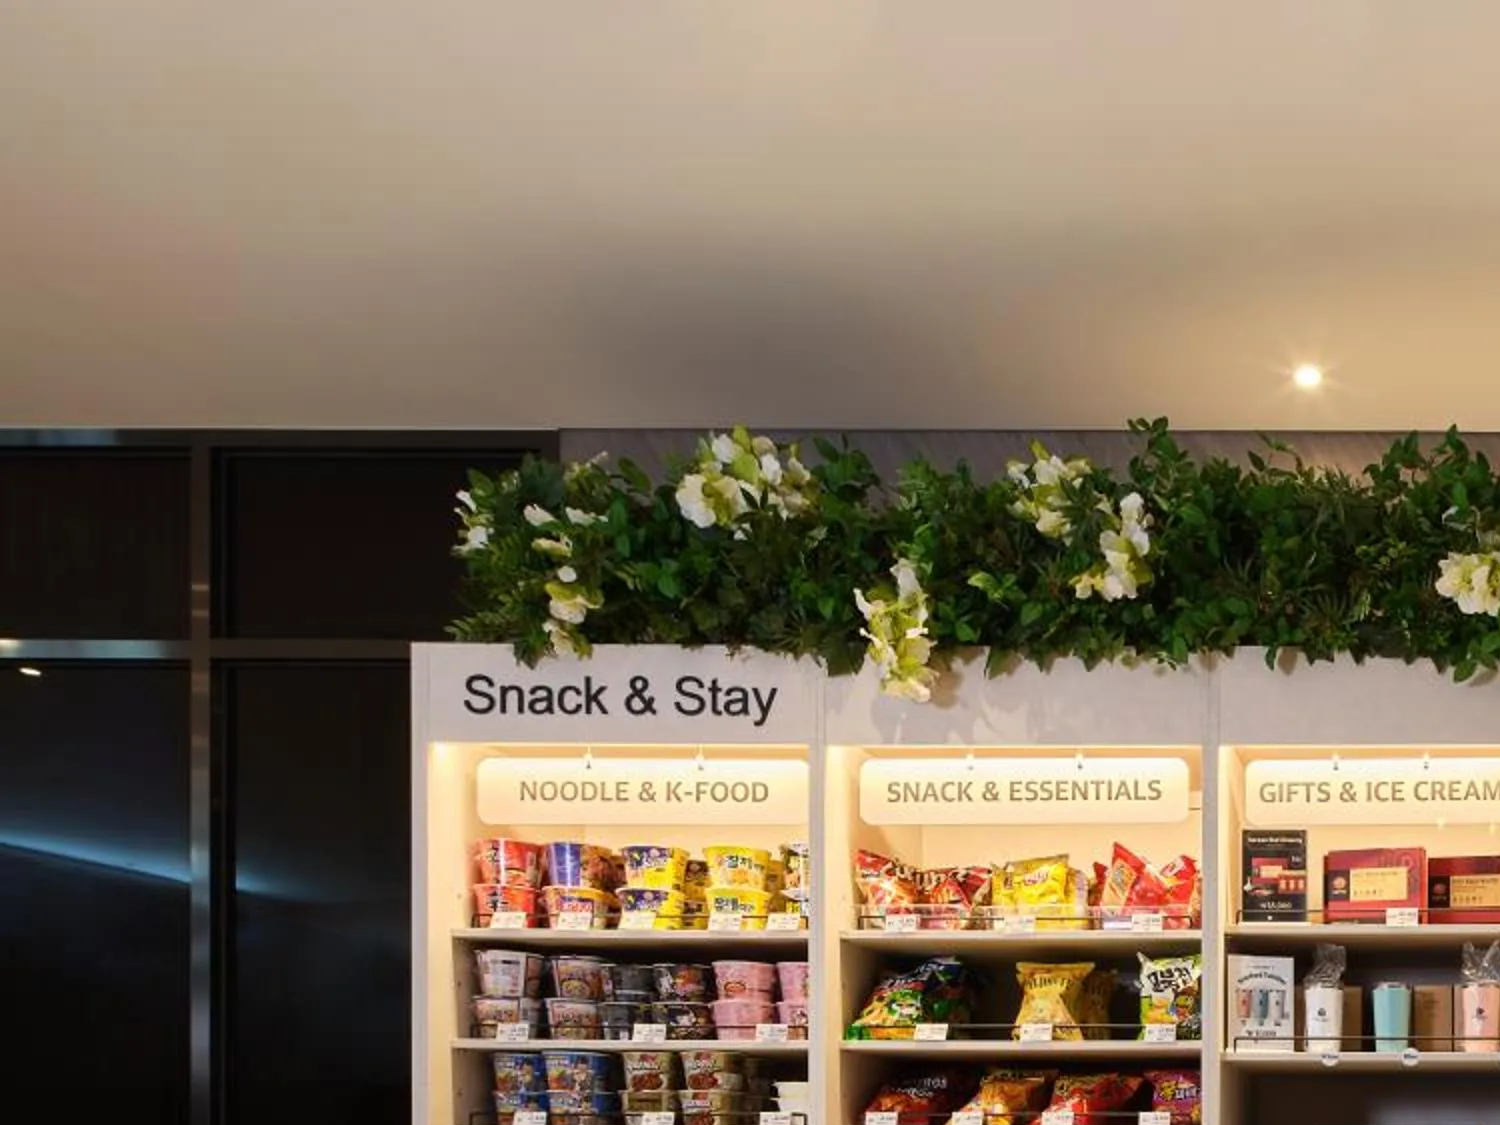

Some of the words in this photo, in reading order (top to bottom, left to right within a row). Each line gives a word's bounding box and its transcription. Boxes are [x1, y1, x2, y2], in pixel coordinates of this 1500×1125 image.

[463, 674, 609, 716] Snack
[623, 675, 657, 716] &
[673, 676, 779, 726] Stay
[519, 781, 630, 803] NOODLE
[638, 781, 657, 803] &
[665, 781, 770, 803] K-FOOD
[887, 781, 973, 804] SNACK
[981, 781, 1000, 803] &
[1008, 779, 1163, 802] ESSENTIALS
[1259, 781, 1332, 804] GIFTS
[1339, 781, 1358, 803] &
[1365, 780, 1406, 803] ICE
